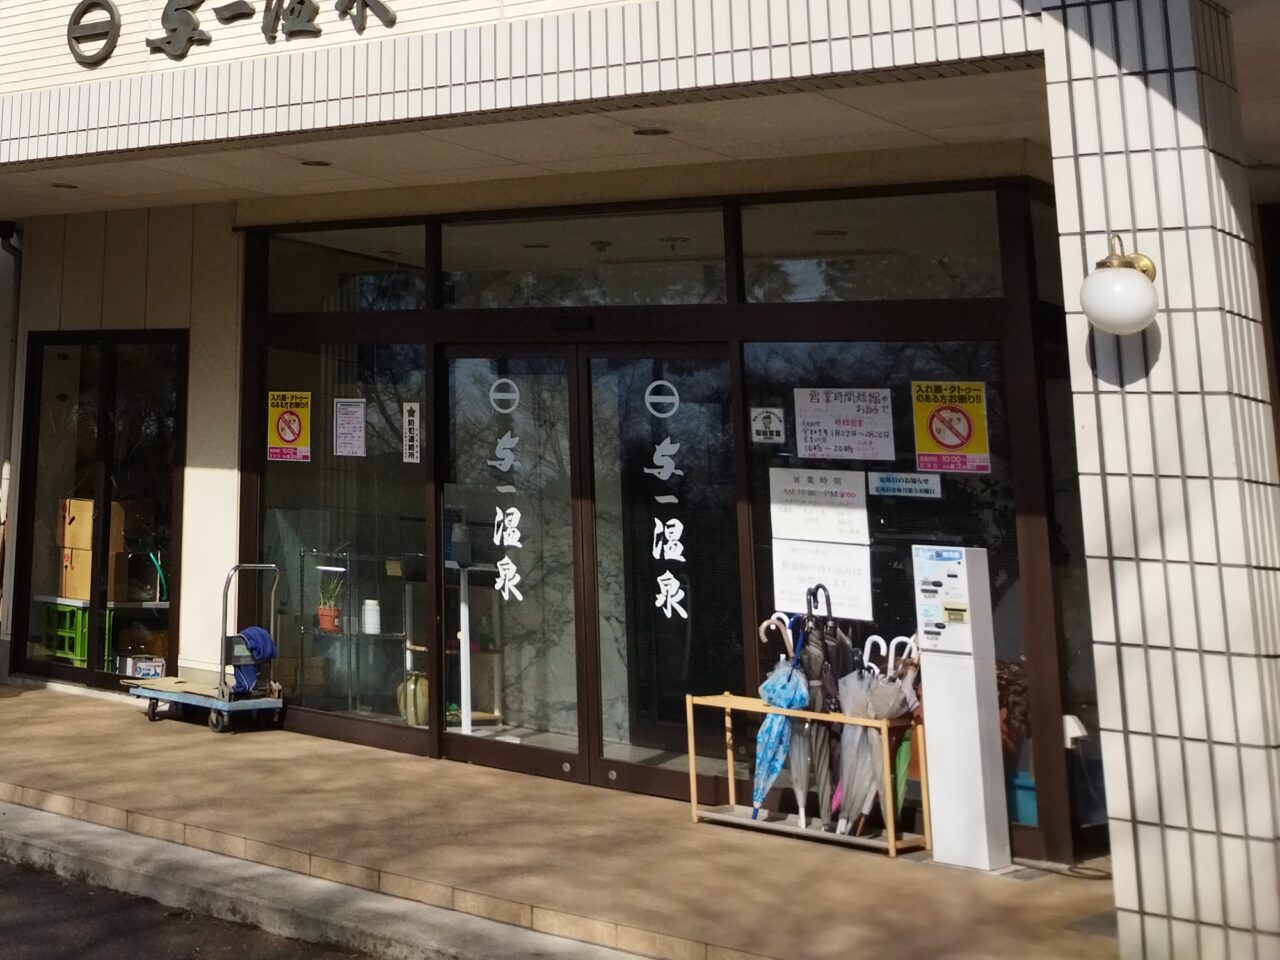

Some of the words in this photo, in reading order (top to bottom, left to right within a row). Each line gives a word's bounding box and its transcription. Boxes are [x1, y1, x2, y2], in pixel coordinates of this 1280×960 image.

[487, 430, 524, 601] 与一温泉
[643, 437, 689, 620] 与一温泉
